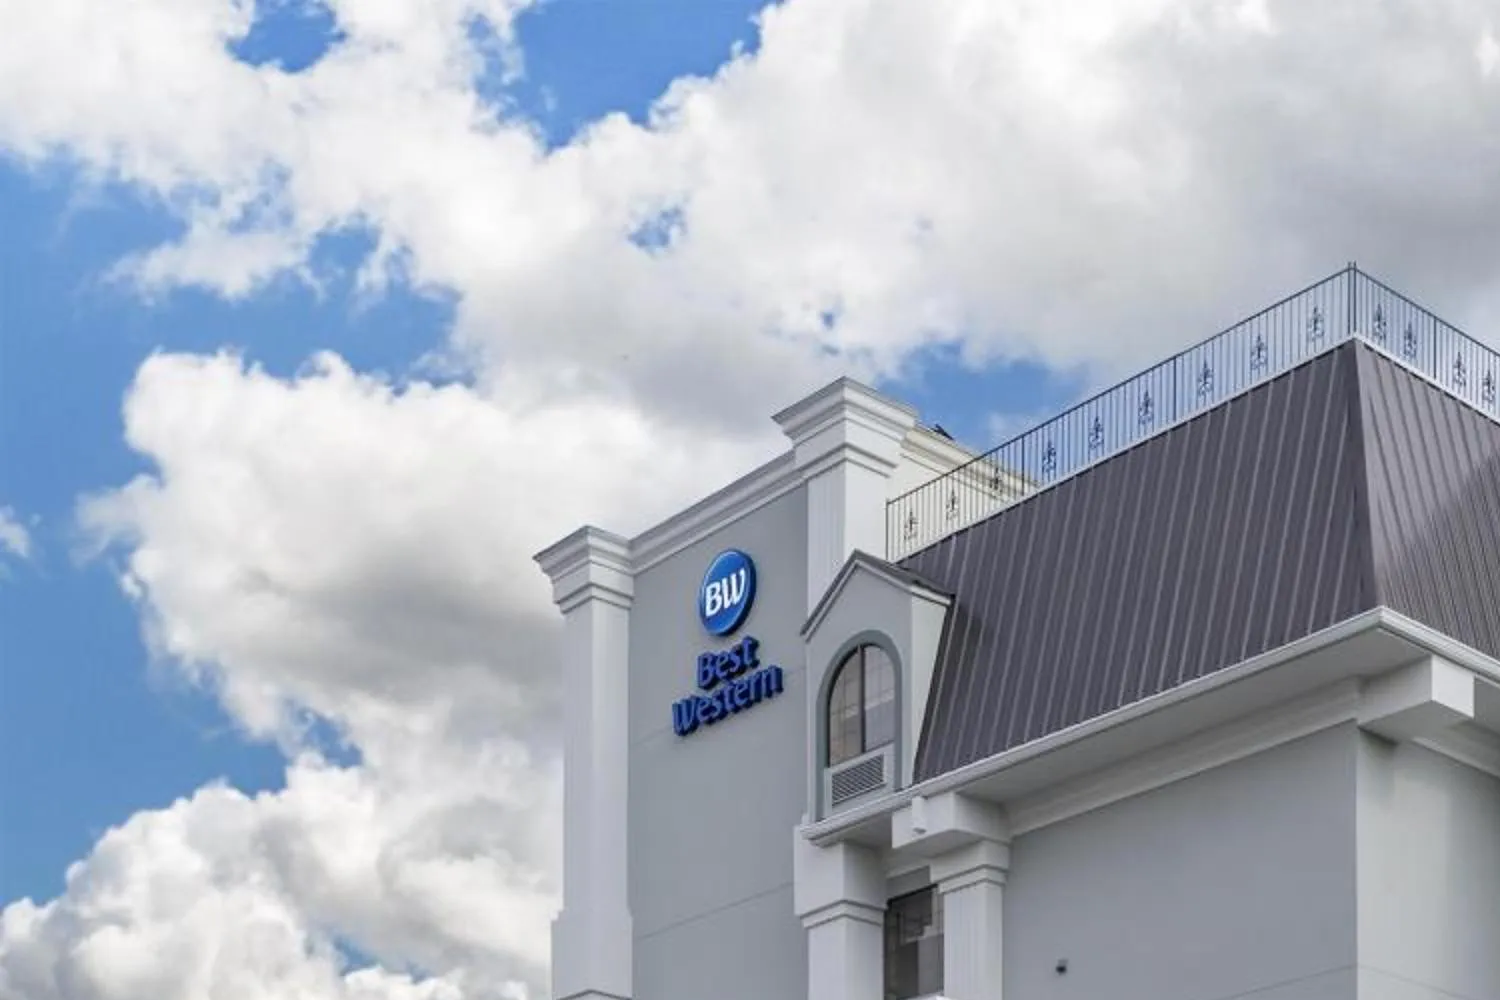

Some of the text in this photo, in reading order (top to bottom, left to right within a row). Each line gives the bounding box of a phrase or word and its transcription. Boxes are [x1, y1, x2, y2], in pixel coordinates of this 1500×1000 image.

[705, 568, 745, 617] BW
[697, 635, 760, 690] Best
[672, 664, 784, 736] Western
